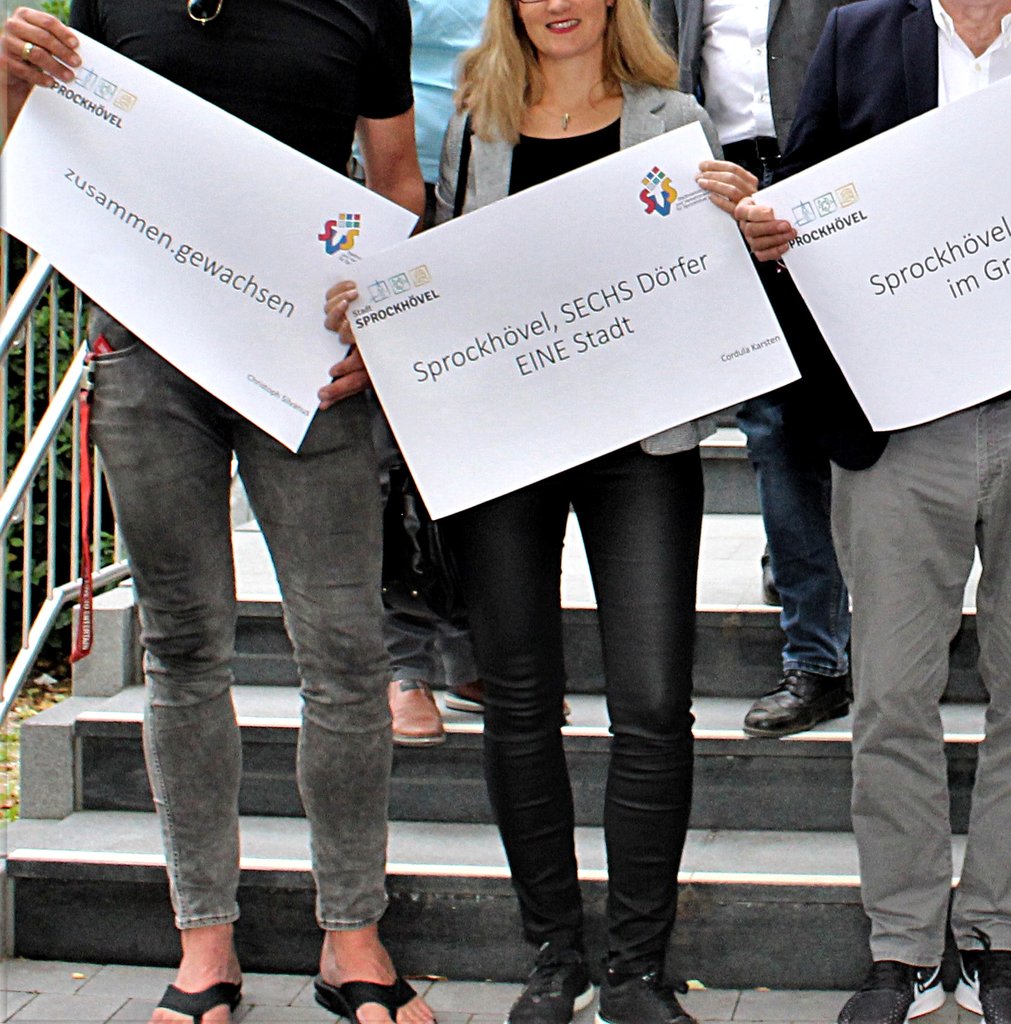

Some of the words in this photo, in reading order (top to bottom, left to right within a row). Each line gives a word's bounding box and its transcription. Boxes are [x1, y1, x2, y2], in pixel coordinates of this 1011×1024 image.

[64, 168, 295, 318] zusammen.gewachsen
[869, 215, 1011, 295] Sprockhövel
[355, 289, 441, 329] SPROCKHÖVEL
[412, 311, 558, 382] Sprockhövel,
[560, 280, 634, 324] SECHS
[636, 253, 708, 294] Dörfer
[947, 274, 980, 299] im
[515, 340, 570, 377] EINE
[573, 315, 635, 354] Stadt
[720, 346, 751, 363] Cordula
[751, 334, 782, 352] Karsten
